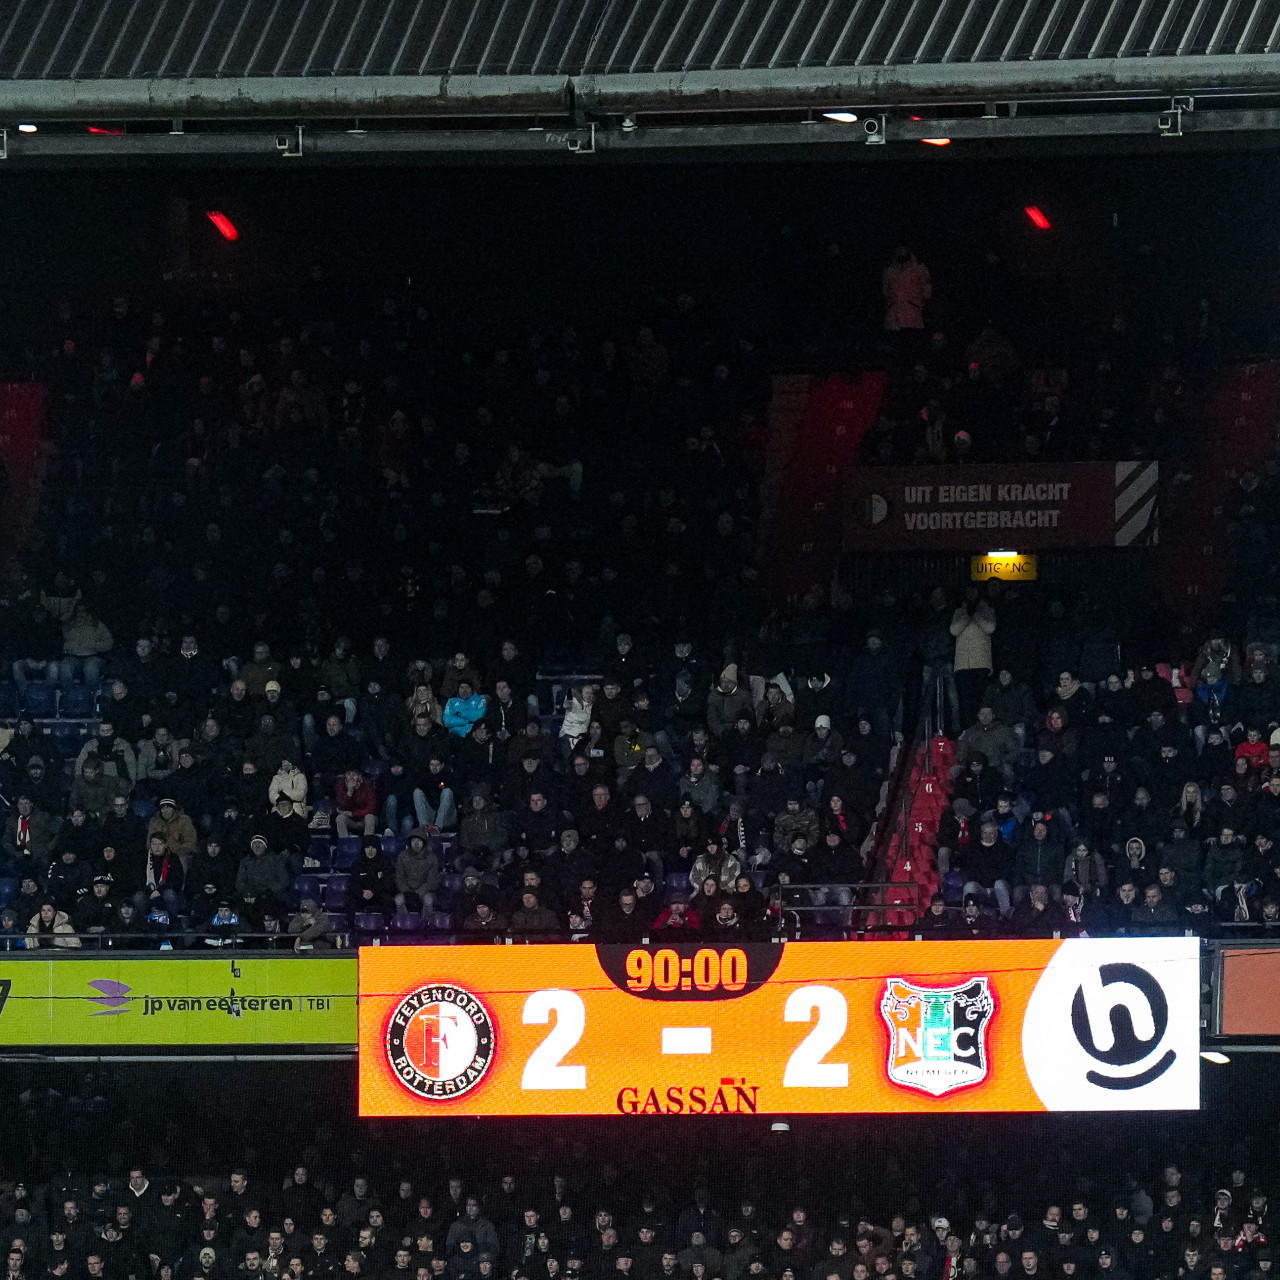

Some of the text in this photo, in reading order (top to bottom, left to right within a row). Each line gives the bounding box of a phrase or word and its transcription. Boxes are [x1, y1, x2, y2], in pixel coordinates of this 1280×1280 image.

[904, 483, 1071, 504] UIT EIGEN KRACHT
[904, 510, 1061, 530] VOORTGEBRACHT
[976, 562, 1031, 573] UITGNG
[626, 948, 748, 992] 90:00
[143, 995, 163, 1016] jp
[166, 997, 202, 1011] van
[307, 998, 330, 1010] TBI
[395, 988, 485, 1026] FEYENOORD
[521, 989, 587, 1090] 2
[783, 987, 849, 1088] 2
[897, 1026, 976, 1058] NEC
[395, 1055, 485, 1094] ROTTERDAM
[616, 1086, 760, 1115] GASSAN
